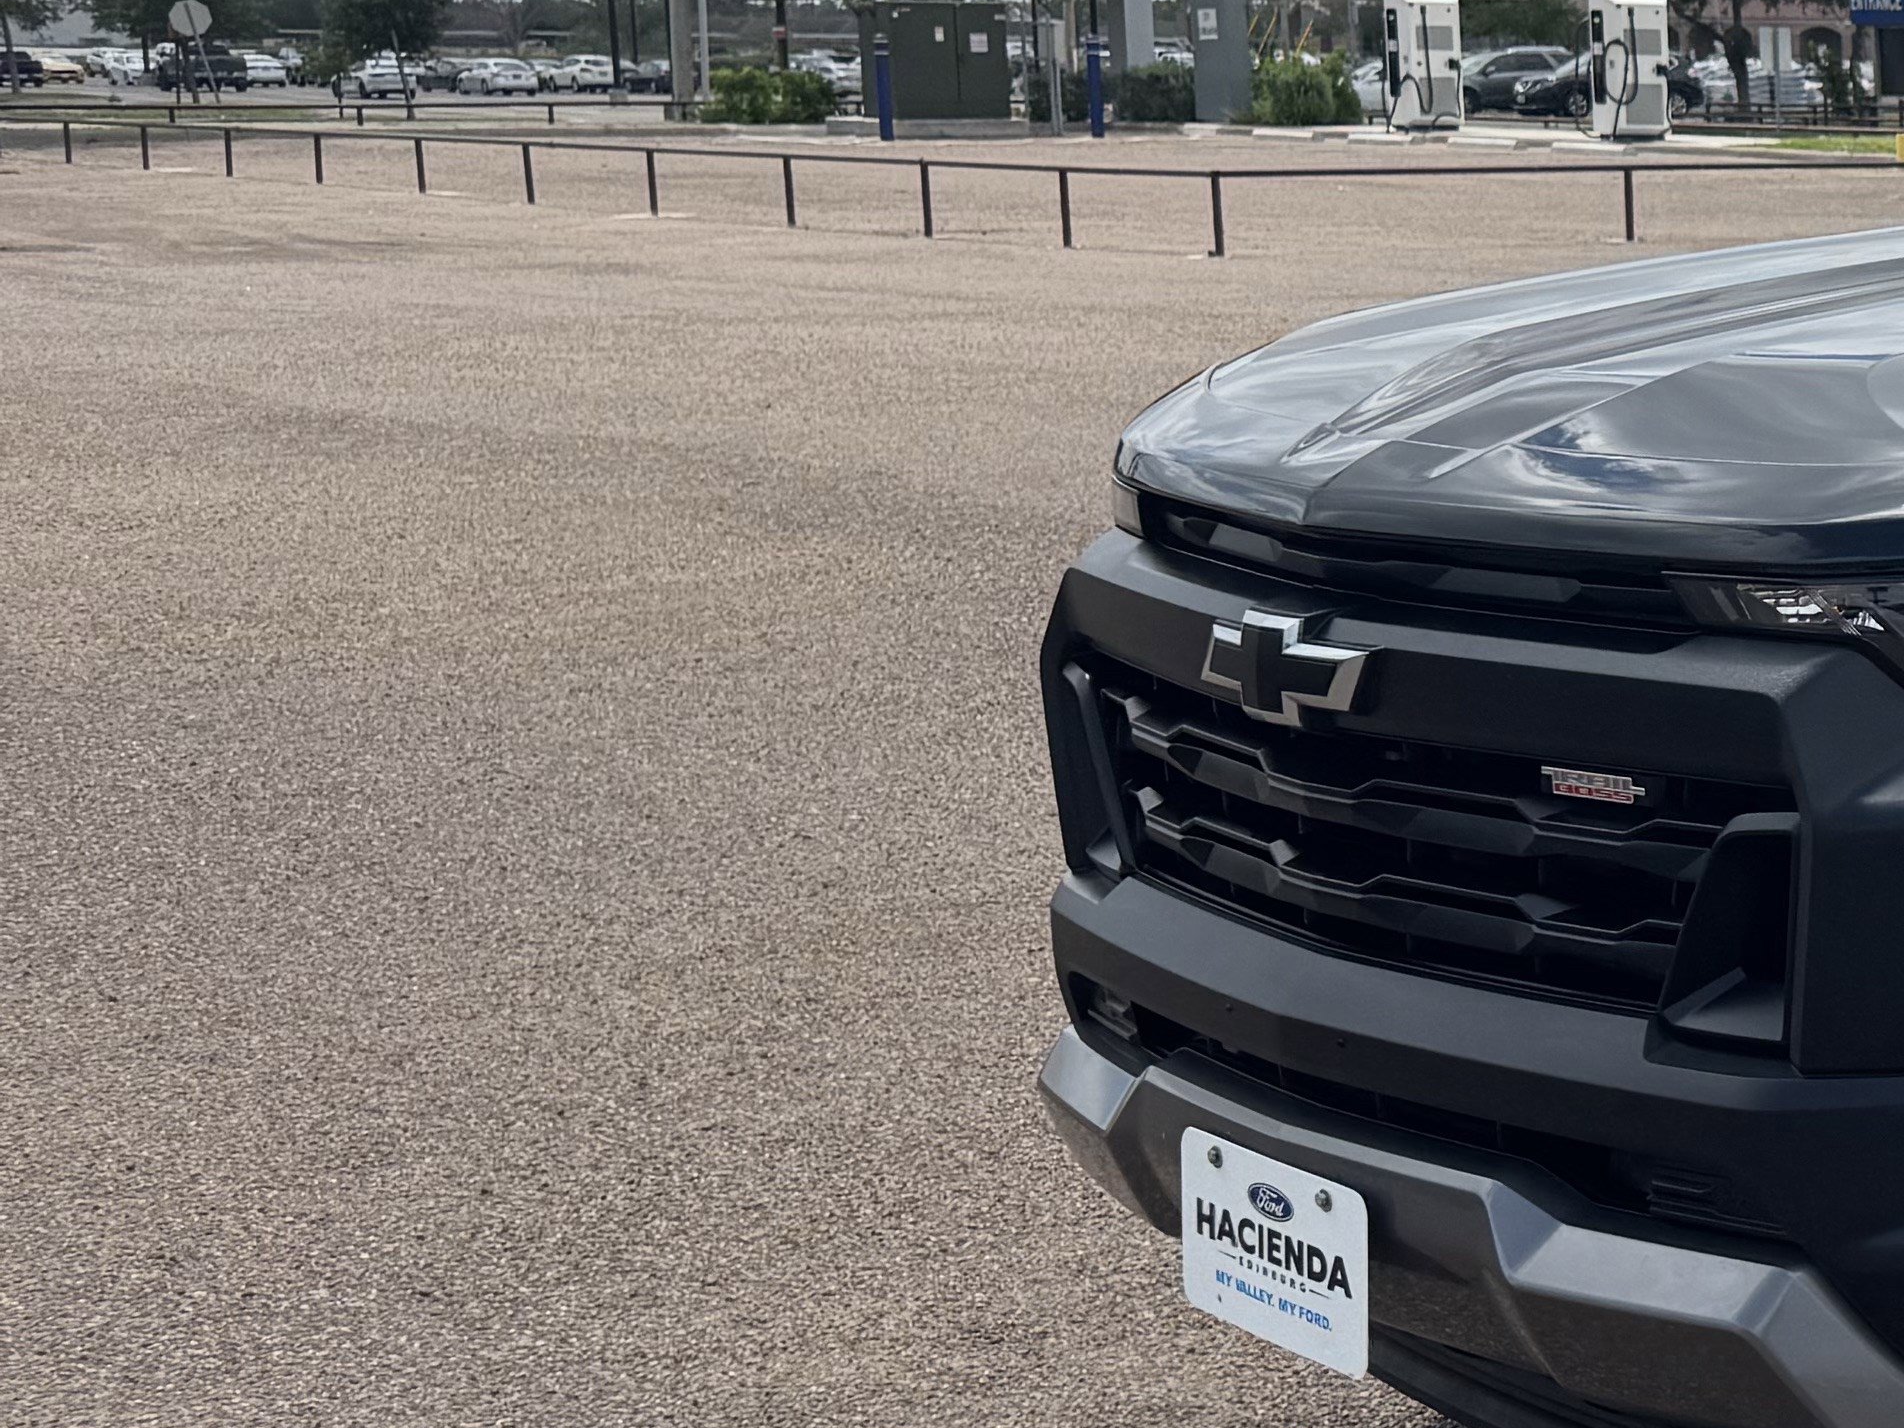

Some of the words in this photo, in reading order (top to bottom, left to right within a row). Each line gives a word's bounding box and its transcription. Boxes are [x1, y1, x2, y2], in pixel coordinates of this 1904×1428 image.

[1541, 765, 1645, 796] TRAIL
[1256, 1186, 1285, 1217] Ford
[1196, 1196, 1353, 1299] HACIENDA
[1239, 1255, 1307, 1293] EDINBURG
[1215, 1269, 1233, 1287] MY
[1235, 1277, 1275, 1307] VALLEY.
[1278, 1297, 1298, 1316] MY
[1299, 1306, 1333, 1332] FORD.
